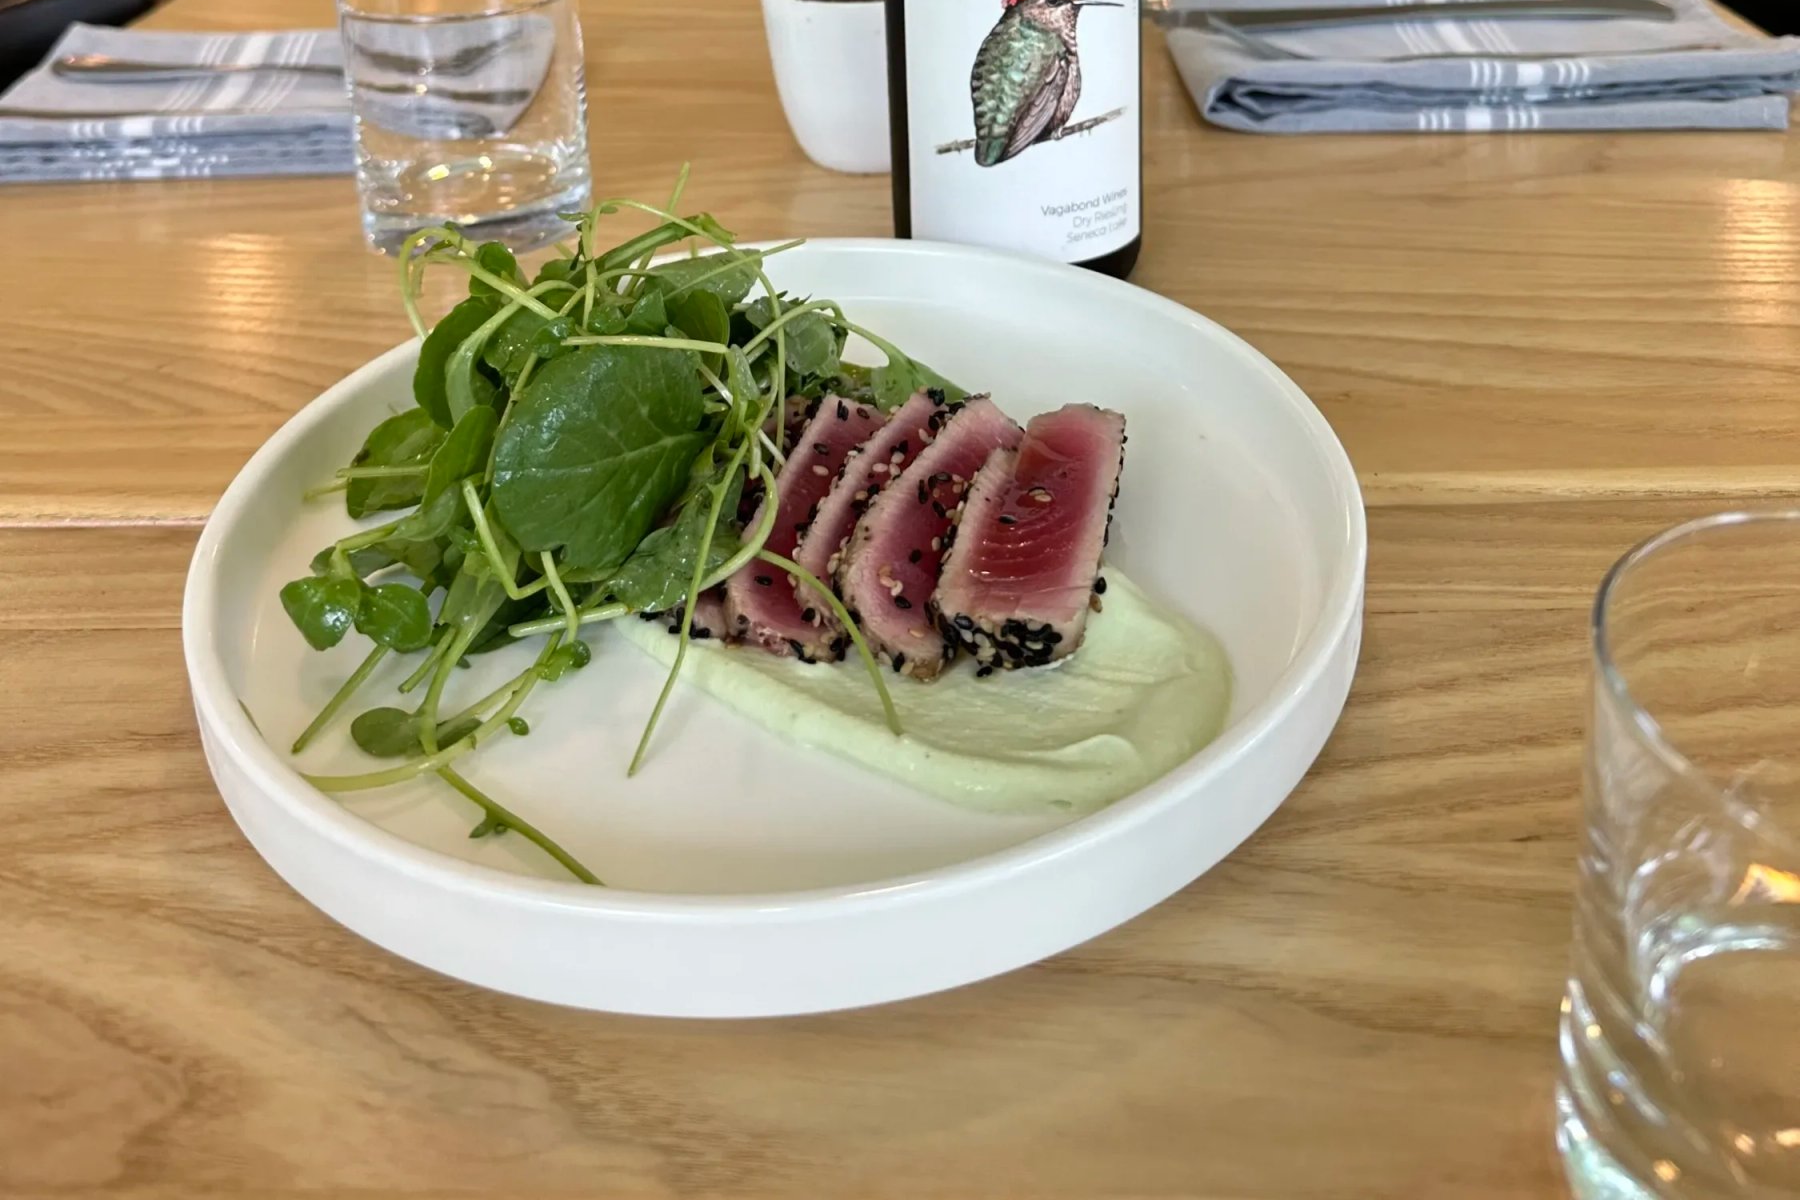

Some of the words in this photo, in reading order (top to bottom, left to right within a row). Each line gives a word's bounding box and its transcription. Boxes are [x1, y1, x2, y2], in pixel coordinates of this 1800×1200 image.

[1040, 196, 1100, 217] Vagabond
[1072, 215, 1092, 229] Dry
[1066, 227, 1107, 244] Seneca
